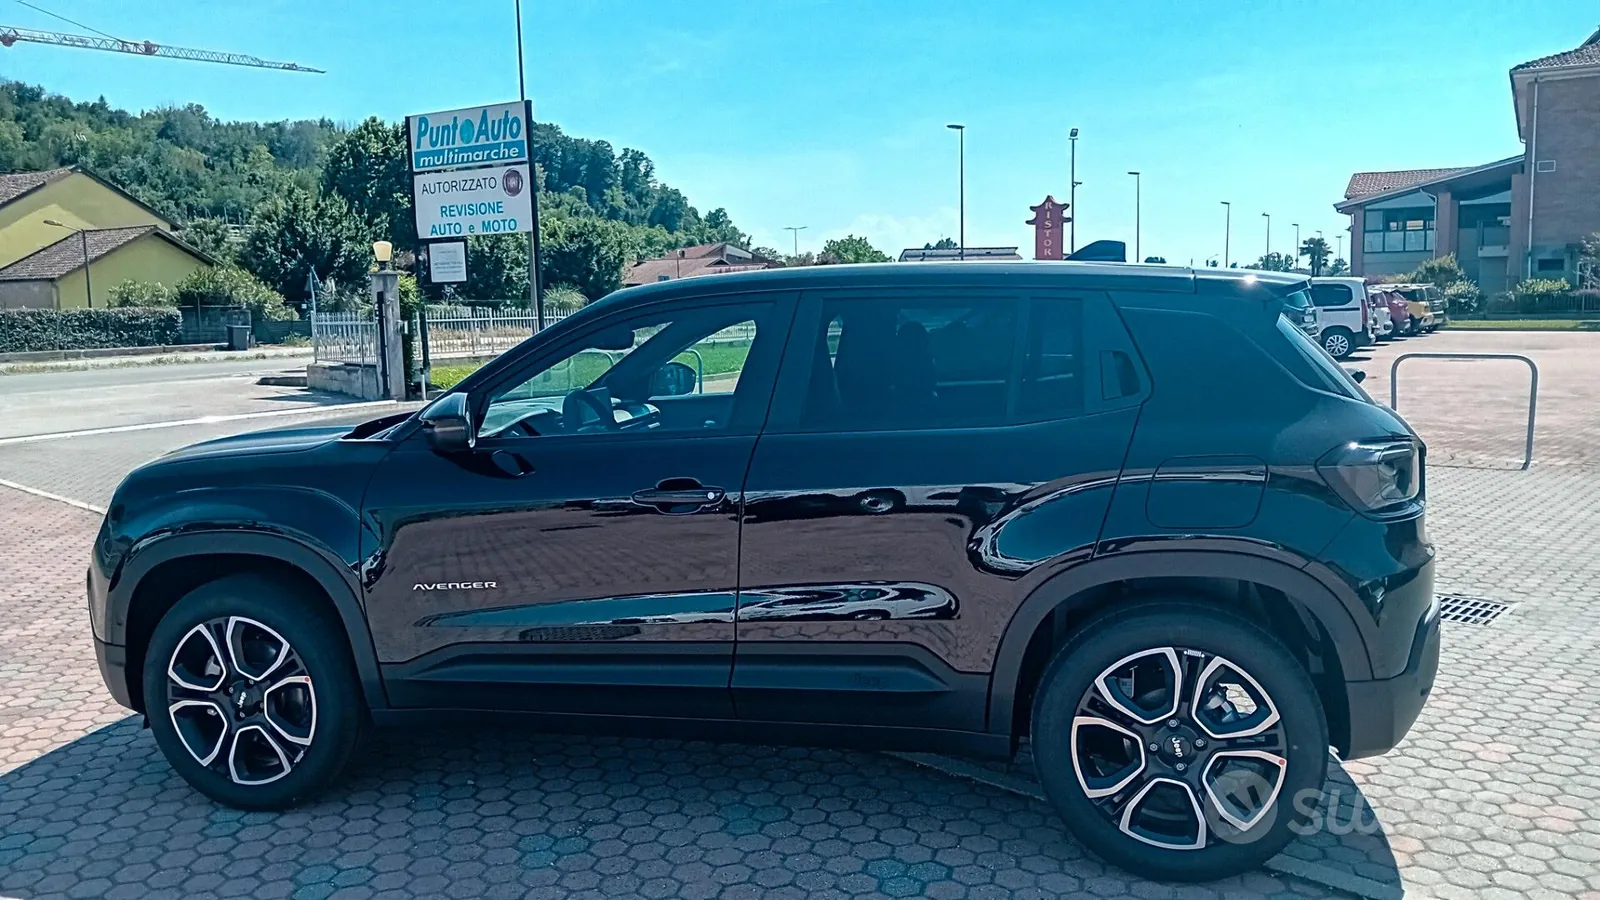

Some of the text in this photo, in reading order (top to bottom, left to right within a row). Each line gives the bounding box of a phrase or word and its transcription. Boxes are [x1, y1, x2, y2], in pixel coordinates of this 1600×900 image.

[420, 143, 519, 167] multimarche
[421, 177, 497, 195] AUTORIZZATO
[440, 201, 504, 218] REVISIONE
[430, 218, 517, 236] AUTO e MOTO
[412, 581, 498, 591] AVENGER
